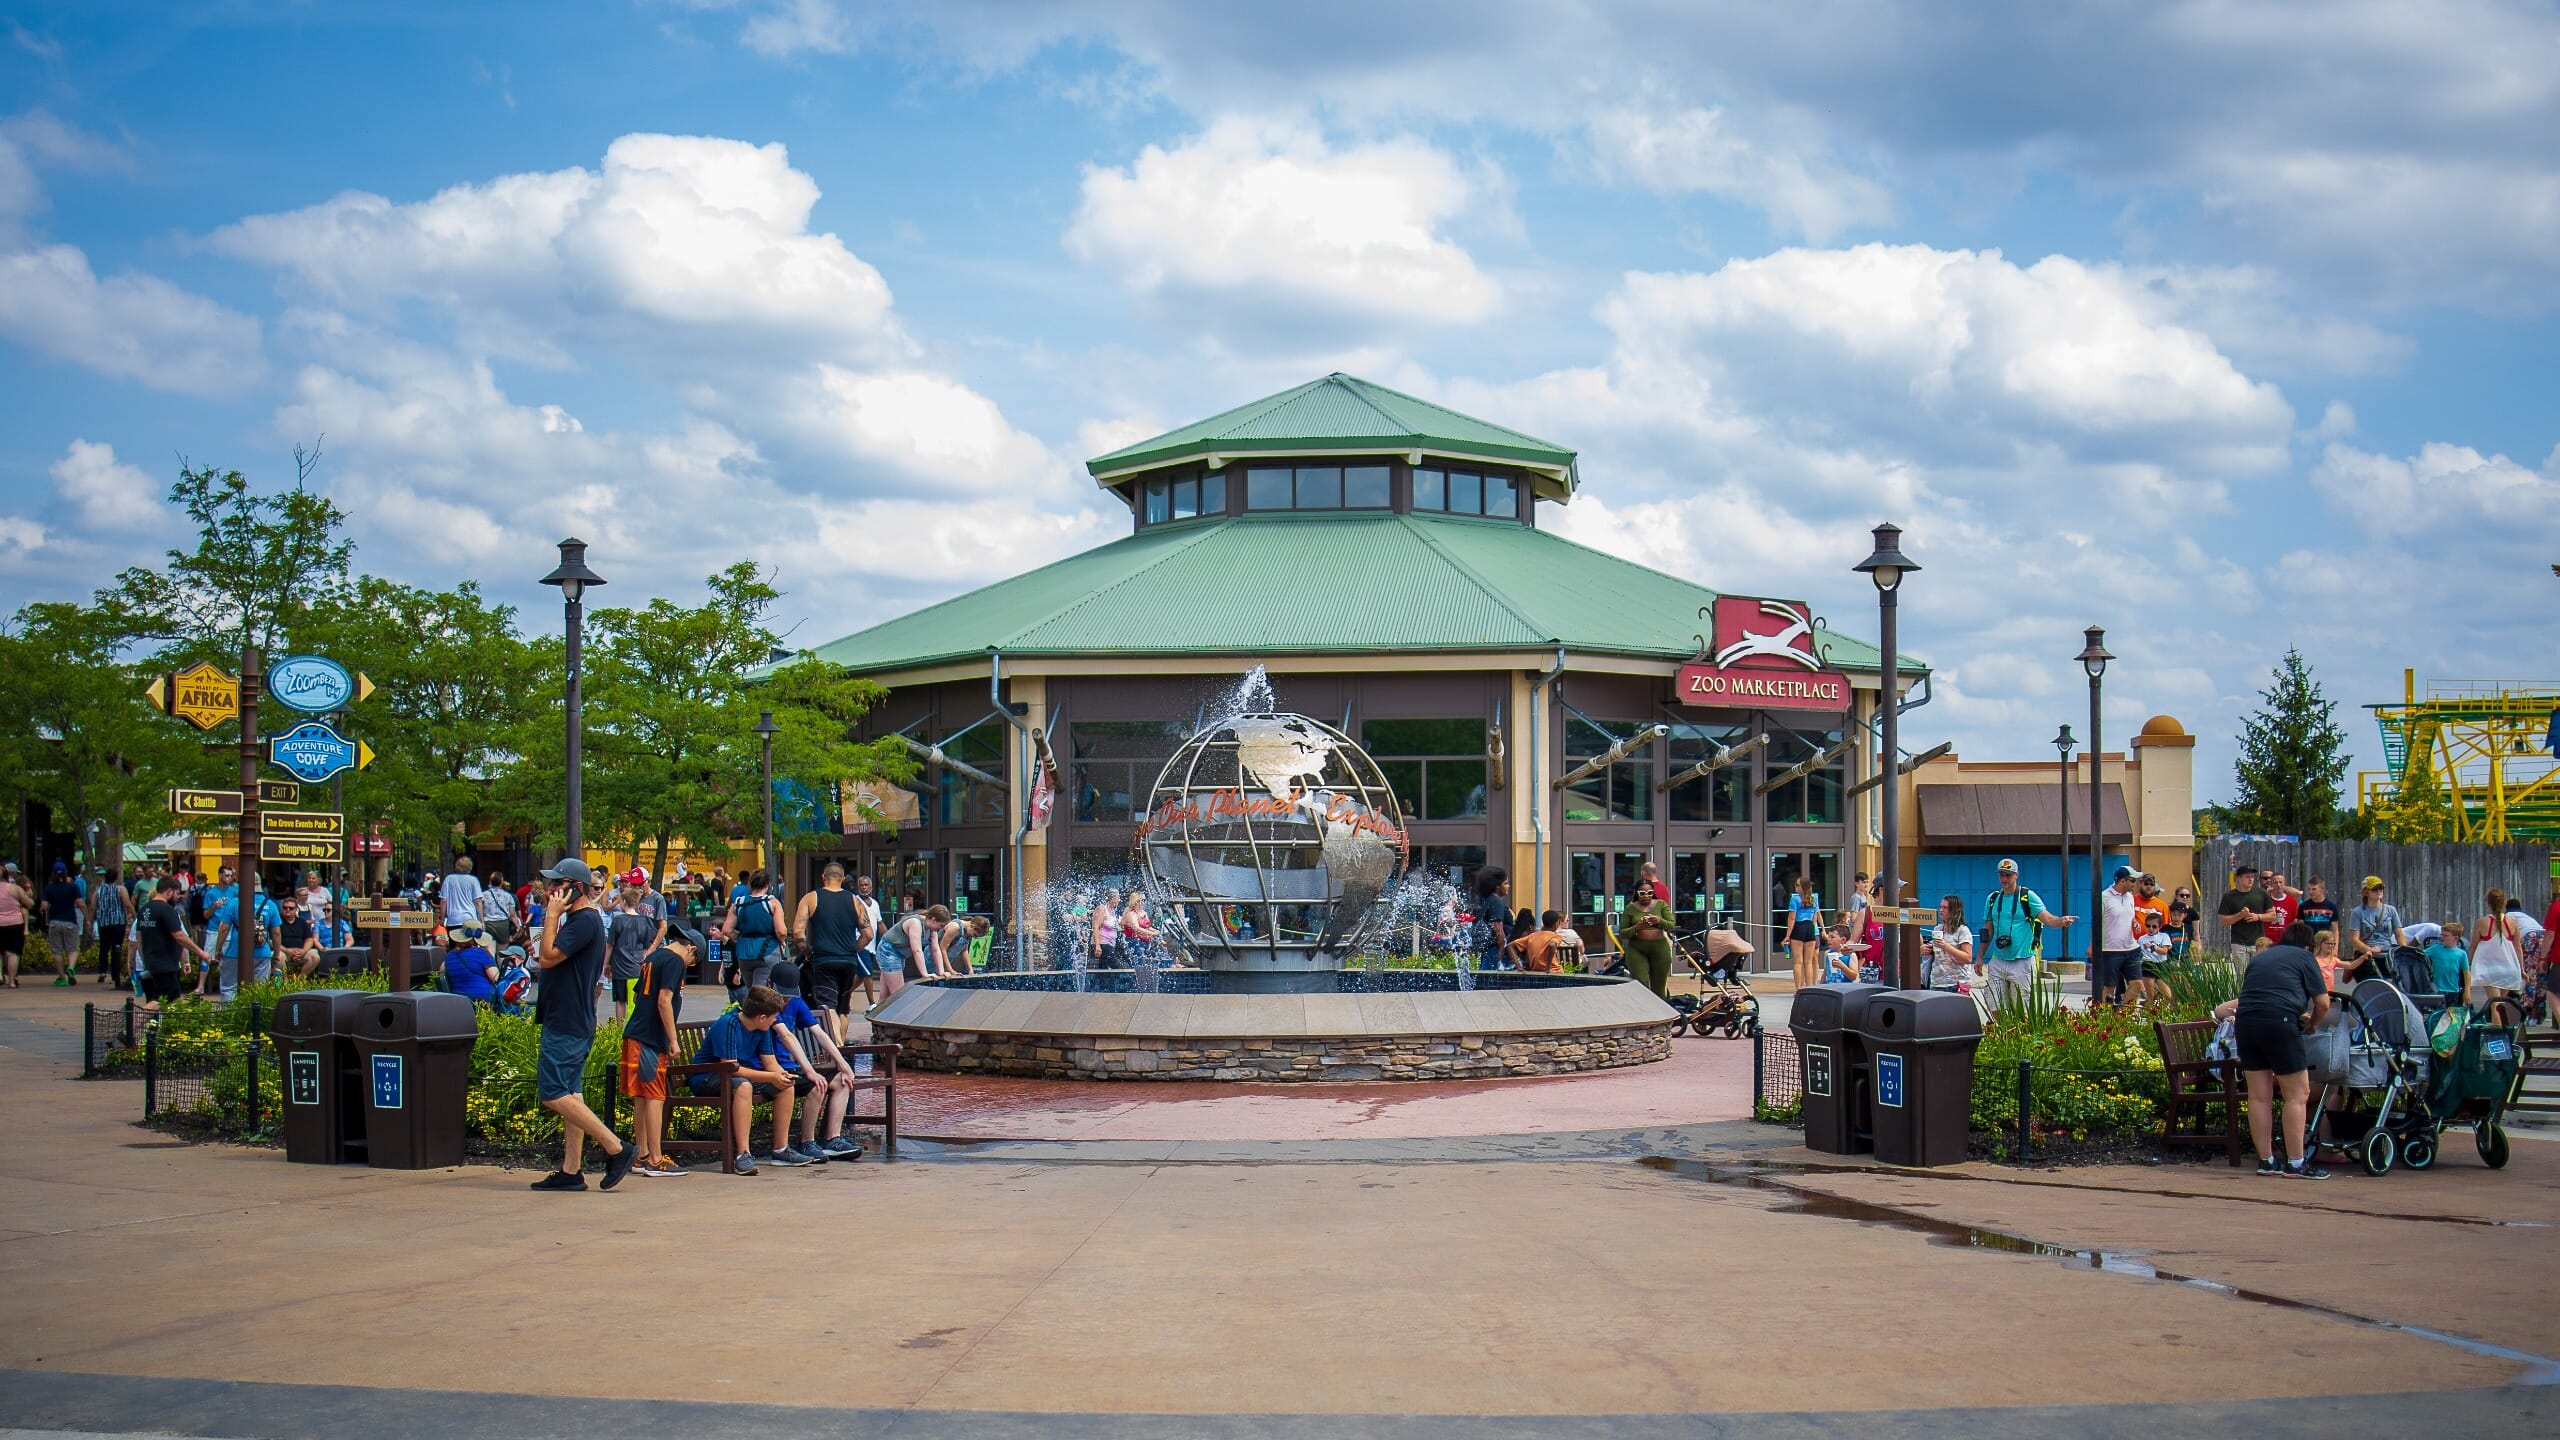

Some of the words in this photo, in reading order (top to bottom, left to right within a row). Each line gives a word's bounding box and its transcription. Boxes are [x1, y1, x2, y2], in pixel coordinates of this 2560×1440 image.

[1690, 676, 1727, 693] ZOO
[1731, 678, 1839, 699] MARKETPLACE
[181, 690, 234, 708] AFRICA
[281, 741, 344, 756] ADVENTURE
[296, 752, 329, 766] COVE
[271, 786, 287, 799] EXIT
[193, 796, 217, 809] Shuttle
[1206, 787, 1301, 821] Planet
[266, 818, 278, 828] The
[278, 819, 295, 829] Grove
[295, 819, 314, 829] Events
[314, 820, 328, 830] Park
[278, 843, 310, 857] Stingray
[310, 845, 326, 857] Bay
[359, 915, 388, 923] LANDFILL
[404, 916, 429, 924] RECYCLE
